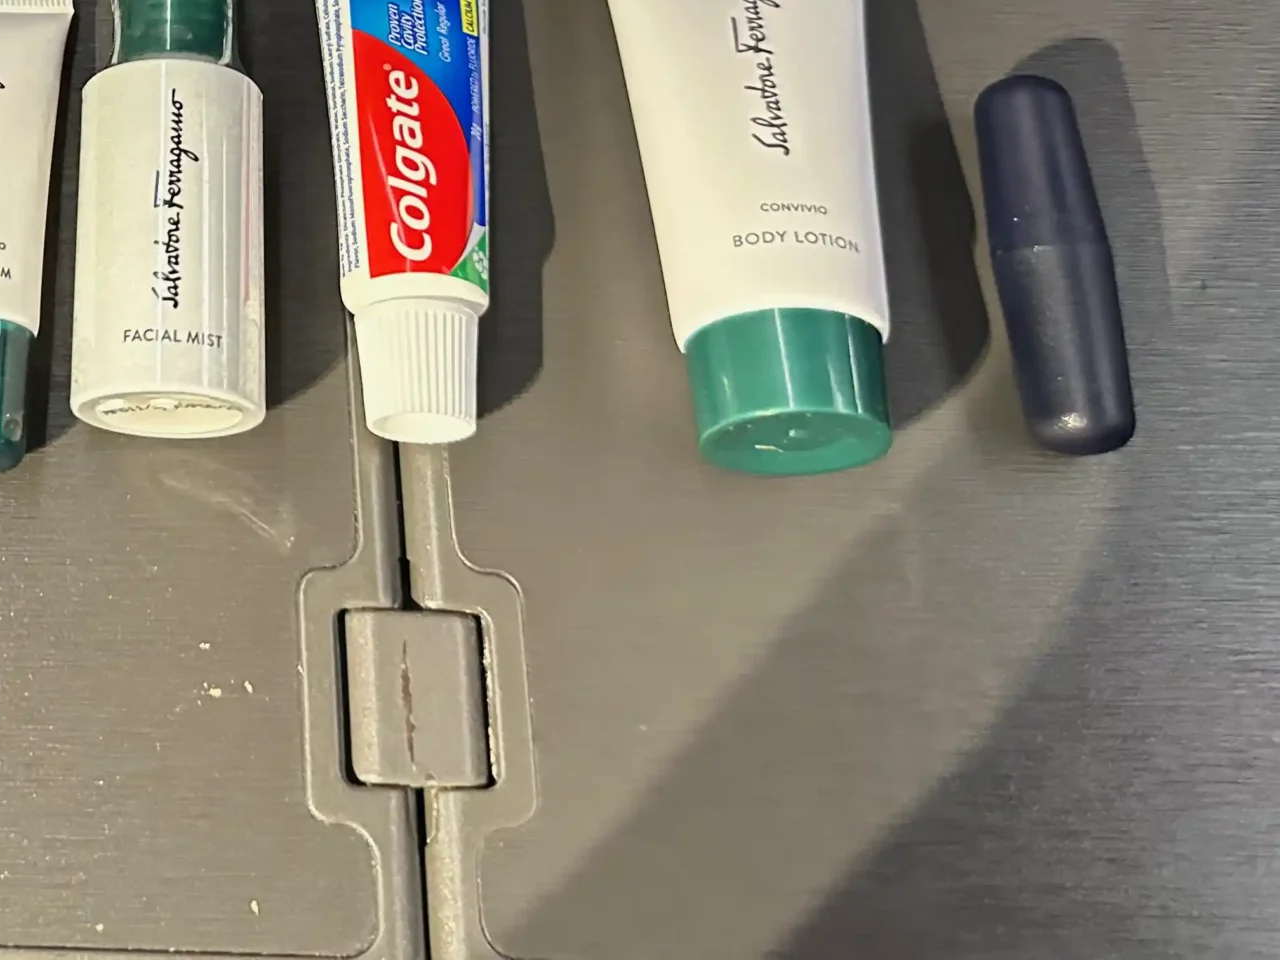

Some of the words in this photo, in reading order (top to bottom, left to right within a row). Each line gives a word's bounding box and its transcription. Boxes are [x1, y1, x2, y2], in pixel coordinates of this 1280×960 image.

[388, 4, 401, 45] Proven
[401, 14, 413, 49] Cavity
[436, 2, 452, 33] Regular
[464, 0, 475, 32] CALCIUM
[439, 37, 451, 62] Great
[467, 37, 478, 70] FLUORIDE
[744, 57, 790, 156] Salvatore
[154, 88, 198, 209] Ferragamo
[760, 203, 827, 215] CONVIVIO
[733, 230, 787, 247] BODY
[794, 230, 860, 253] LOTION
[152, 212, 180, 308] Salvatore
[123, 329, 181, 343] FACIAL
[187, 331, 222, 348] MIST
